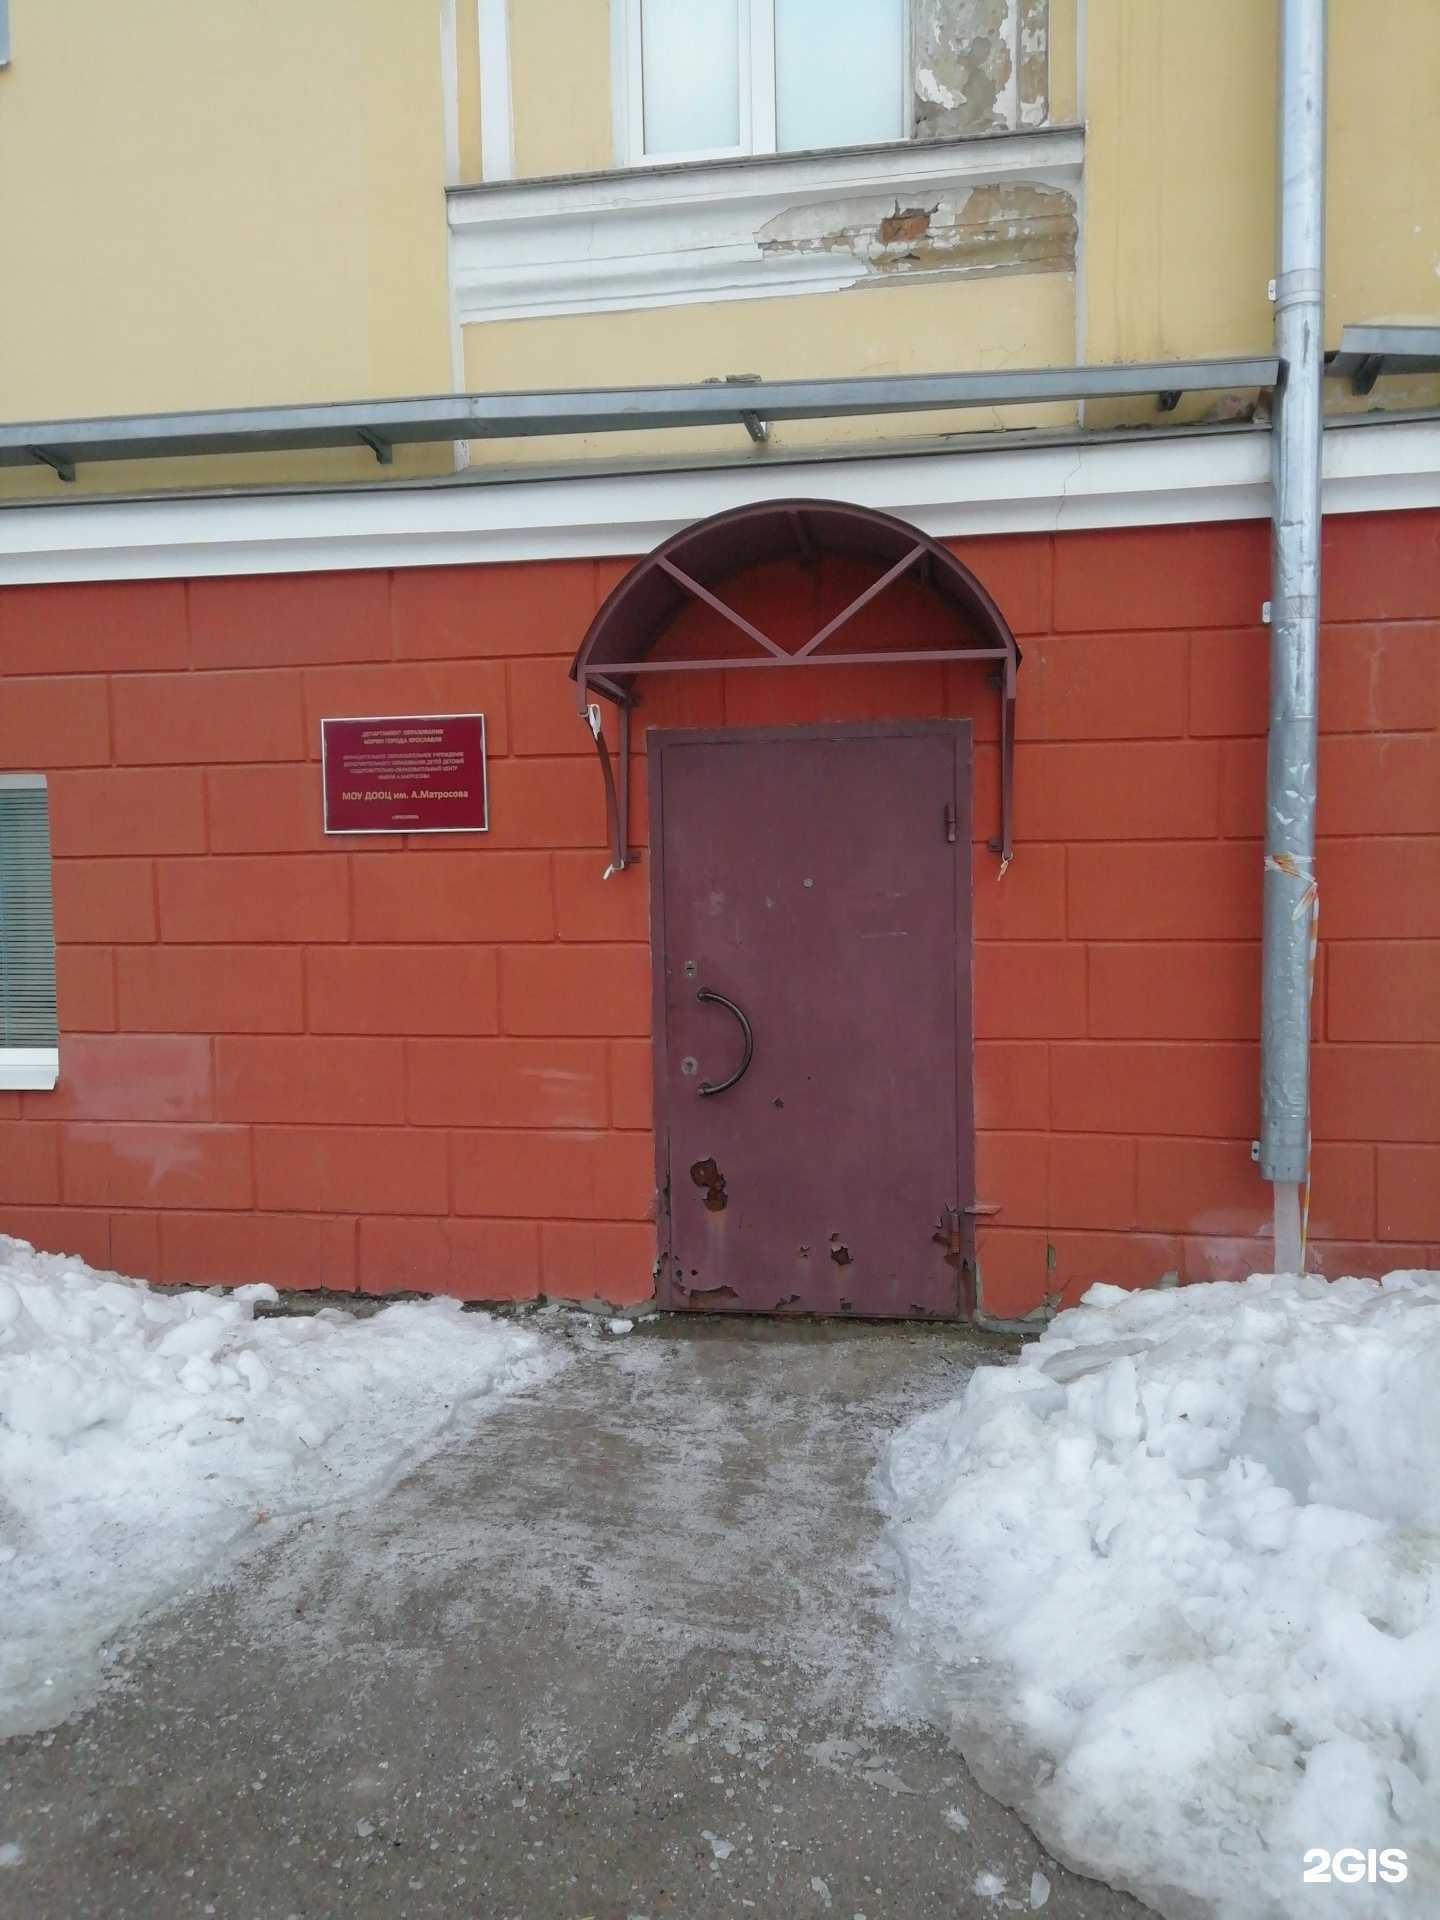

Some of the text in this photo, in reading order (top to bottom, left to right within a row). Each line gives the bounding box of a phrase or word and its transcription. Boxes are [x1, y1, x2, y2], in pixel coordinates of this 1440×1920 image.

[342, 789, 469, 801] МОУ ДООЦ им. А.Матросова
